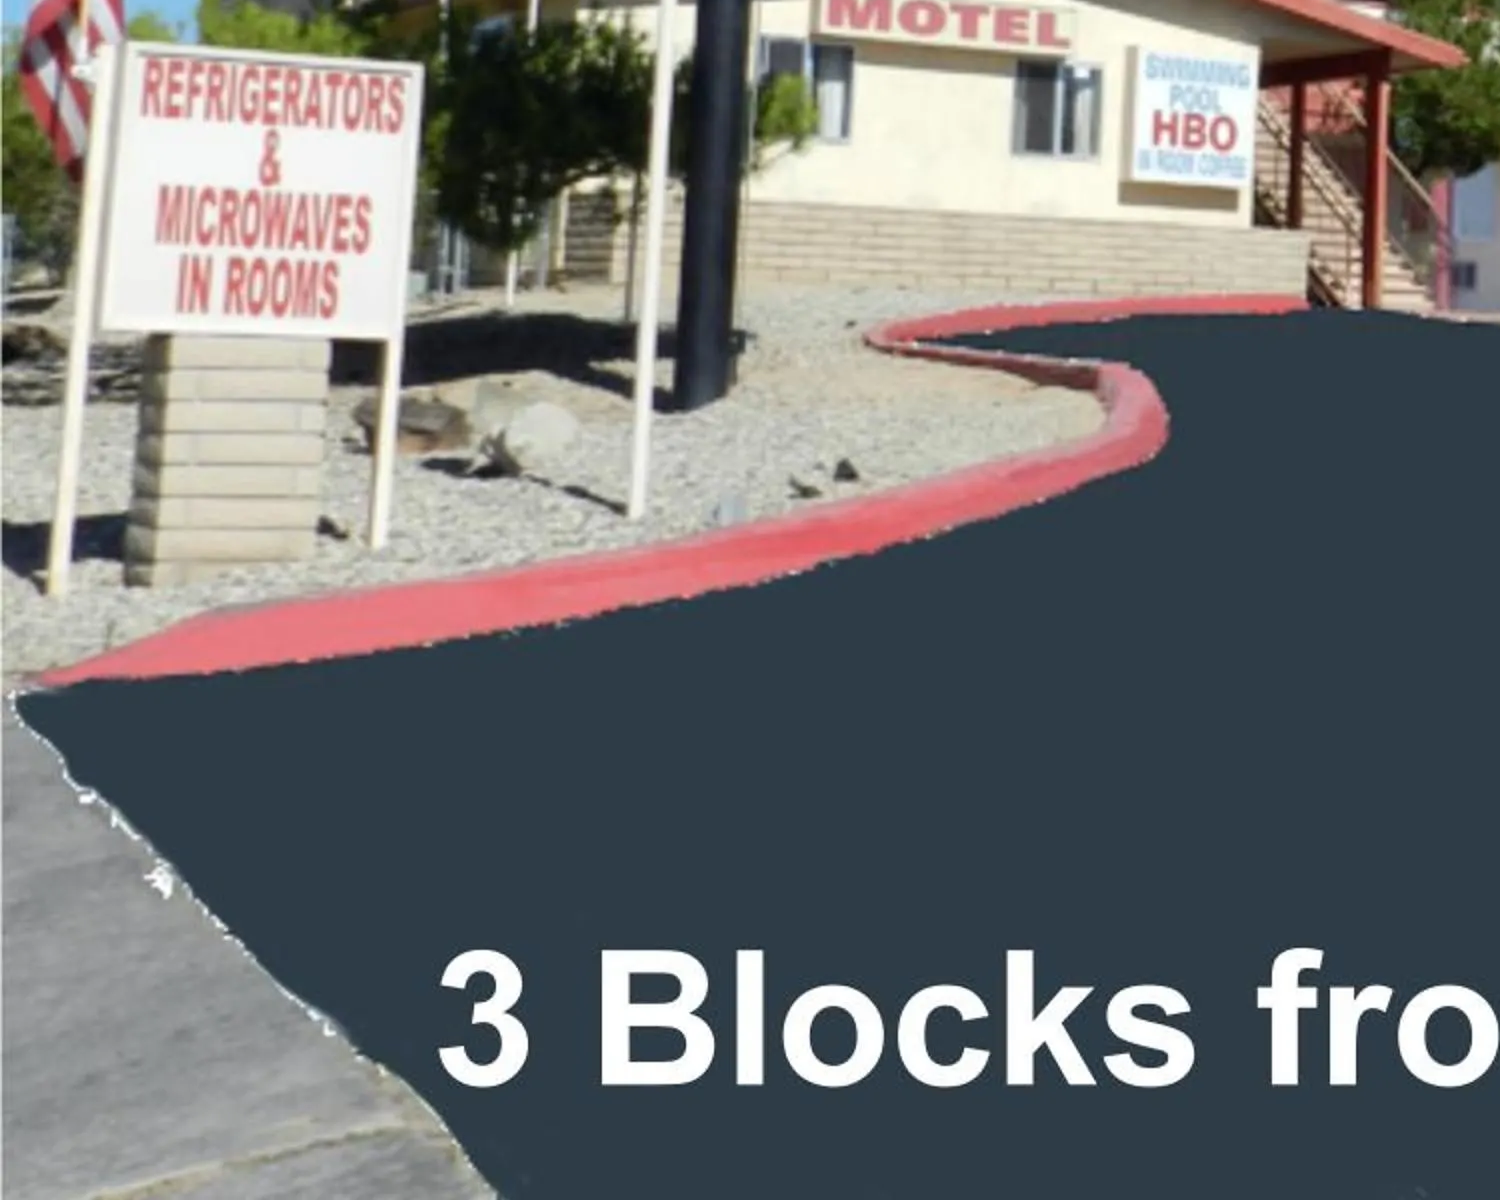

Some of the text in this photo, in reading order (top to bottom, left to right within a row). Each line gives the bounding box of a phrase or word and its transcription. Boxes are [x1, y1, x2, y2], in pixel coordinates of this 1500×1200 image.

[140, 57, 406, 134] REFRIGERATORS
[1145, 52, 1250, 89] SWIMMING
[1169, 83, 1222, 113] POOL
[258, 129, 282, 187] &
[1152, 108, 1238, 153] HBO
[155, 185, 373, 255] MICROWAVES
[175, 254, 340, 320] IN ROOMS
